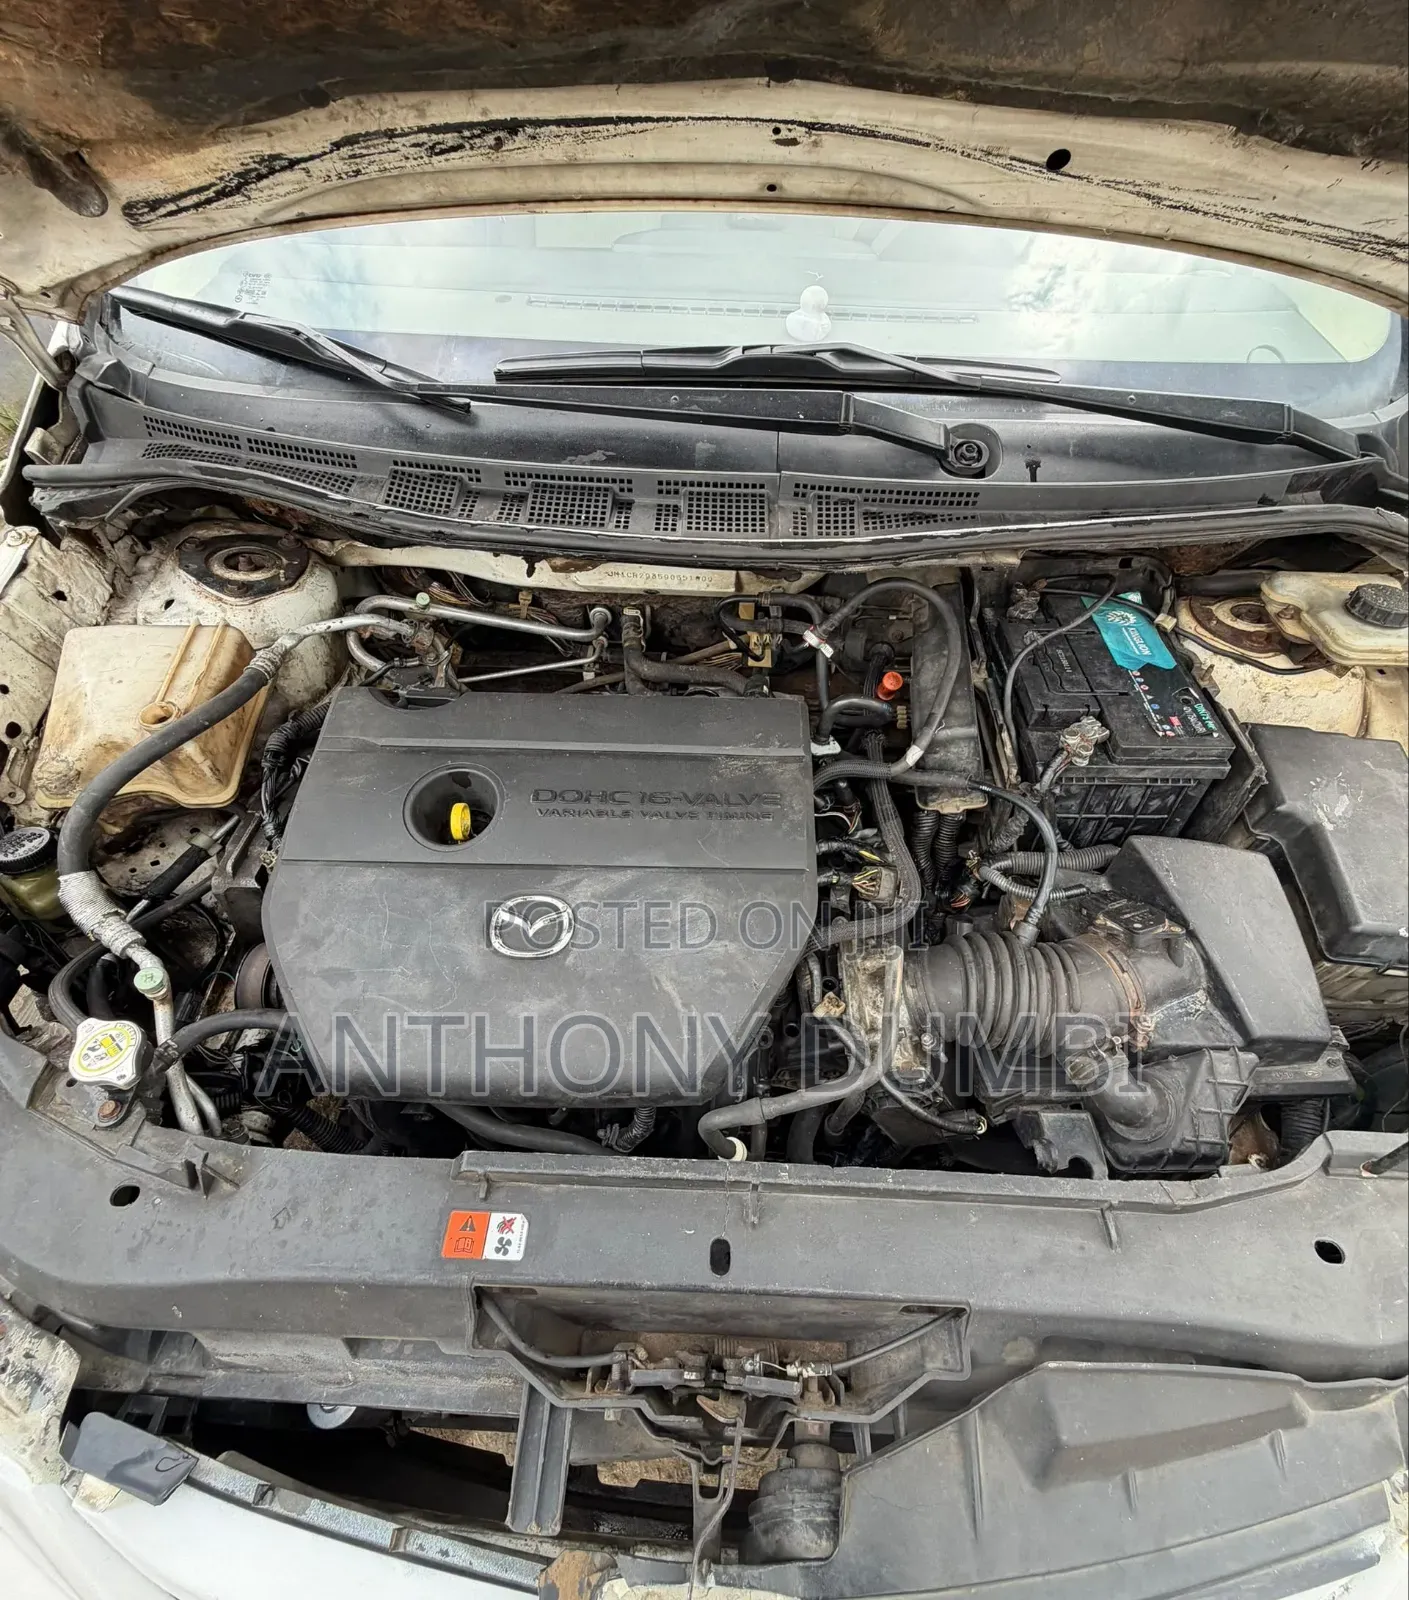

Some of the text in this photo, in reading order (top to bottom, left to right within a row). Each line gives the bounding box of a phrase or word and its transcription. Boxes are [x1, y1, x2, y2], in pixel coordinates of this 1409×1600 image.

[530, 789, 782, 808] DOHC 16-VALVE
[536, 808, 774, 821] VARIABLE VALVE TIMING
